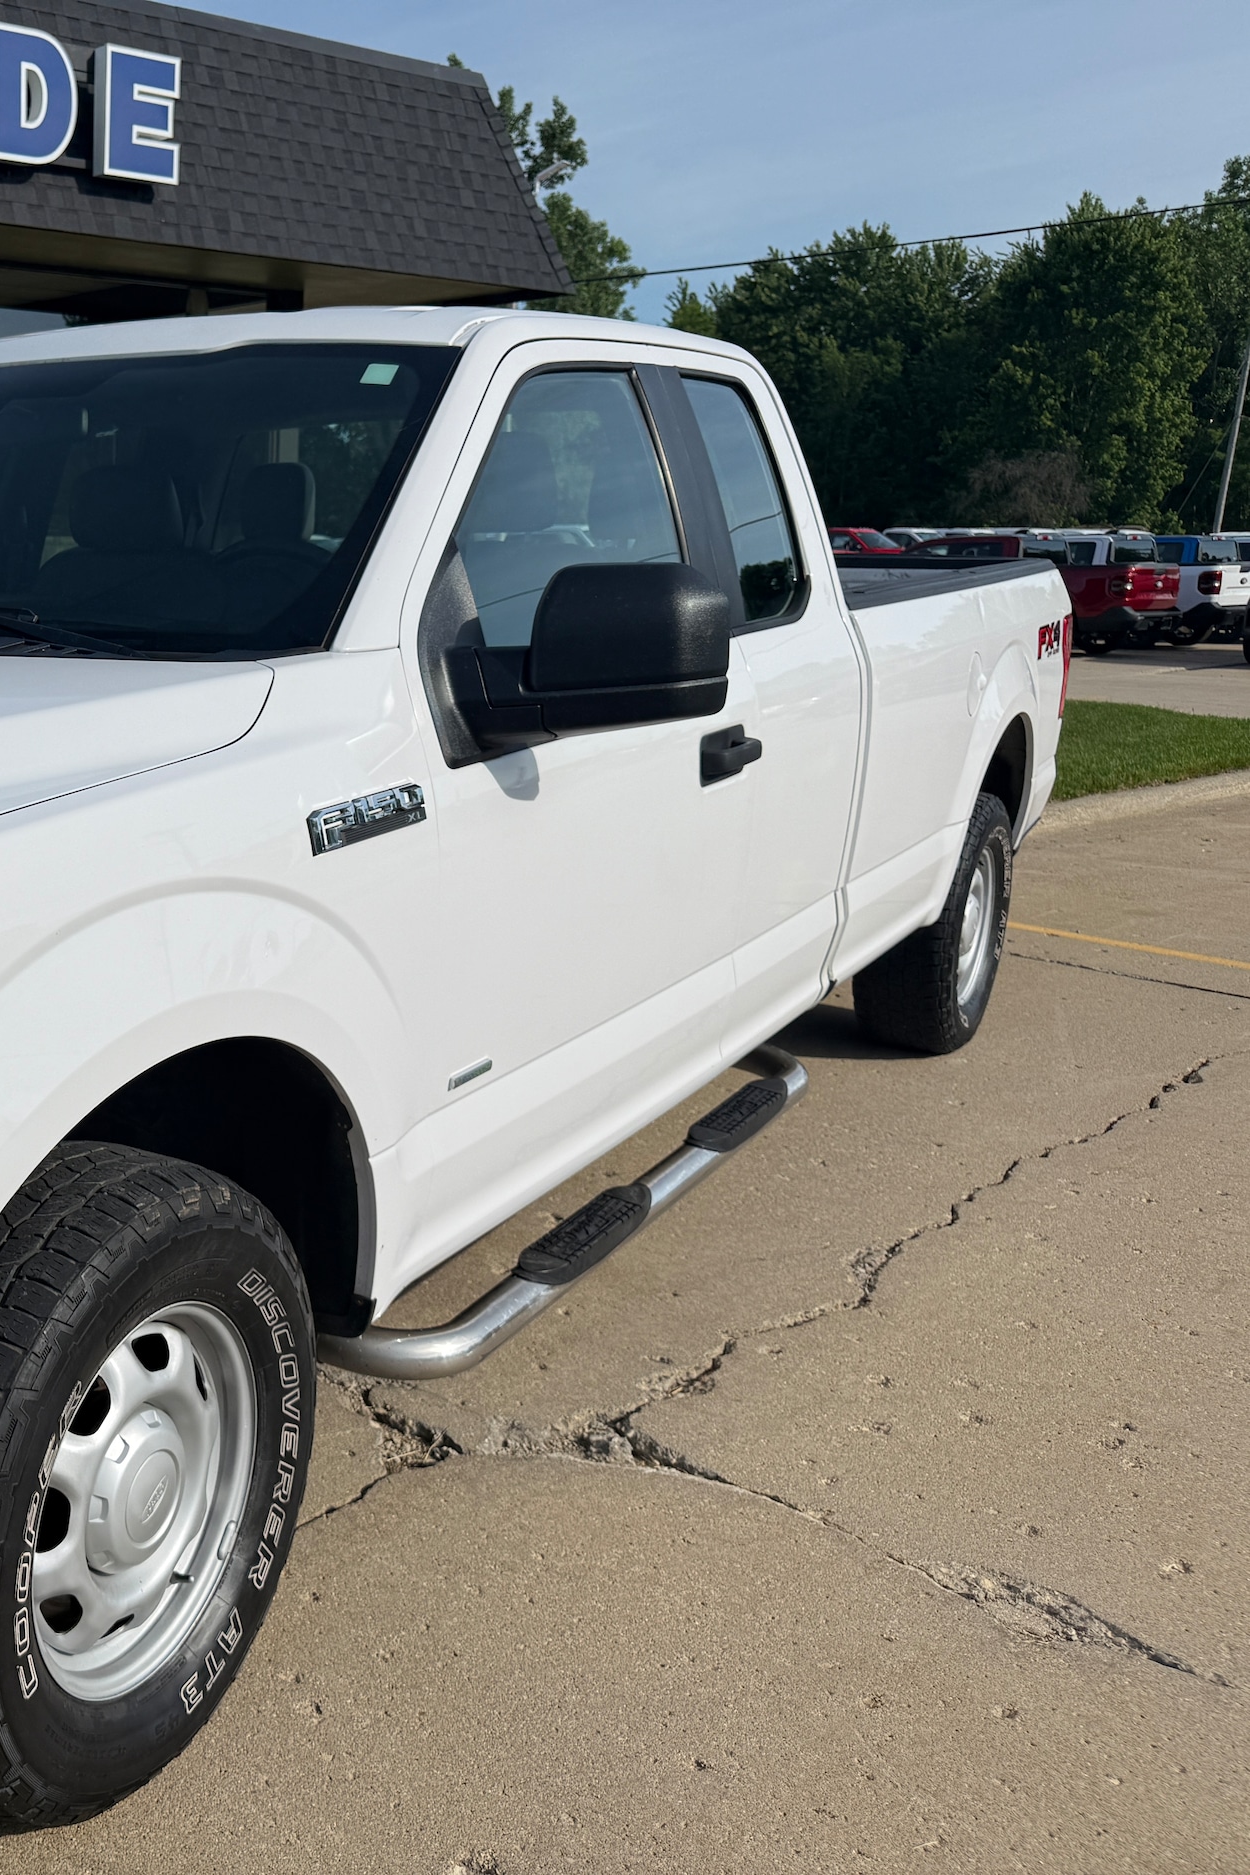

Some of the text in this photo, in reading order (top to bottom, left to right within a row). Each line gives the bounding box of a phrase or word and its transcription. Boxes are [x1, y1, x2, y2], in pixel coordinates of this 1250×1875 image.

[1037, 620, 1060, 660] FX4
[406, 811, 422, 824] XL
[236, 1267, 301, 1591] DISCOVERER
[180, 1606, 243, 1714] AT3
